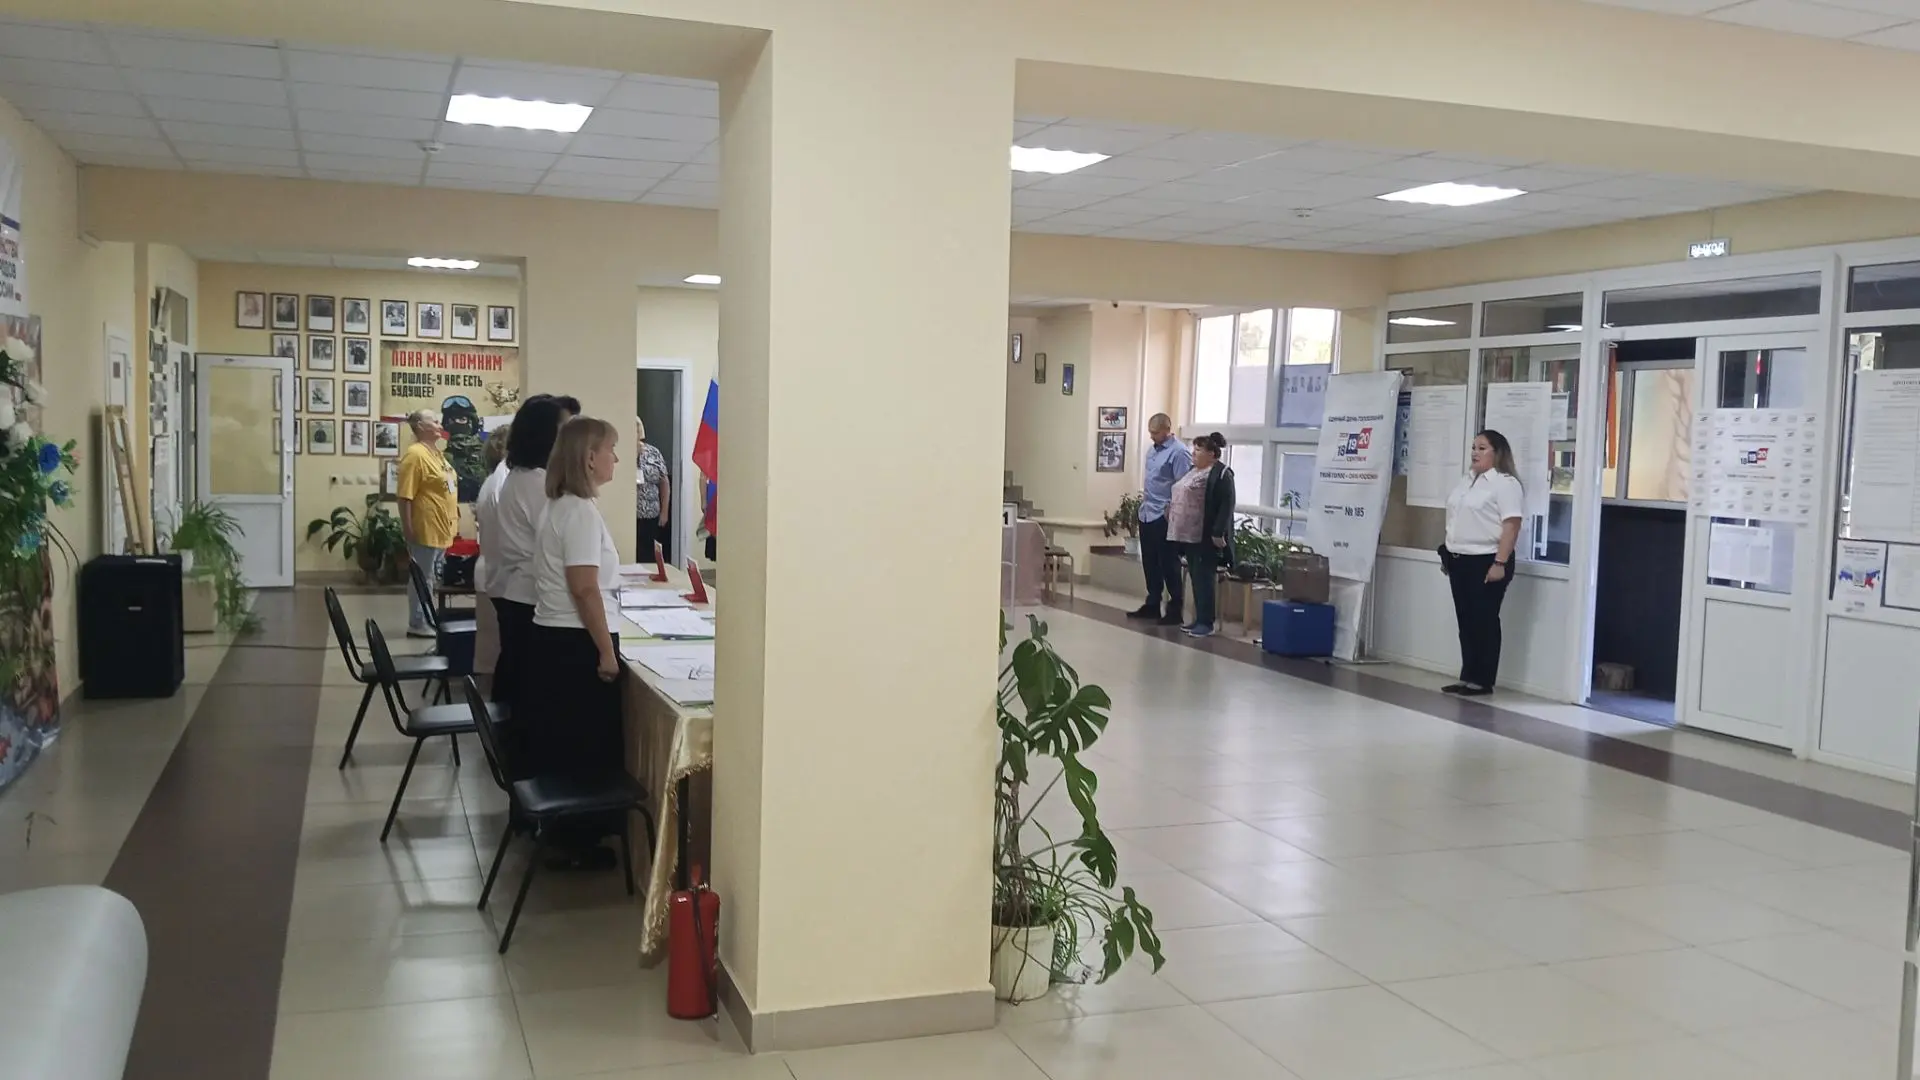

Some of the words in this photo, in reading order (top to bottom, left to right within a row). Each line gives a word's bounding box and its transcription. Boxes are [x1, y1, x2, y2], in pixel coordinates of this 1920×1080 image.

[1691, 242, 1725, 258] ВЫХОД
[392, 350, 422, 368] ПОКА
[427, 351, 447, 369] МЫ
[452, 353, 502, 371] ПОМНИМ
[445, 374, 460, 387] НАС
[463, 375, 483, 388] ЕСТЬ
[391, 385, 434, 398] БУДУЩЕЕ!
[1337, 445, 1345, 457] 18
[1348, 438, 1357, 451] 19
[1358, 432, 1370, 445] 20
